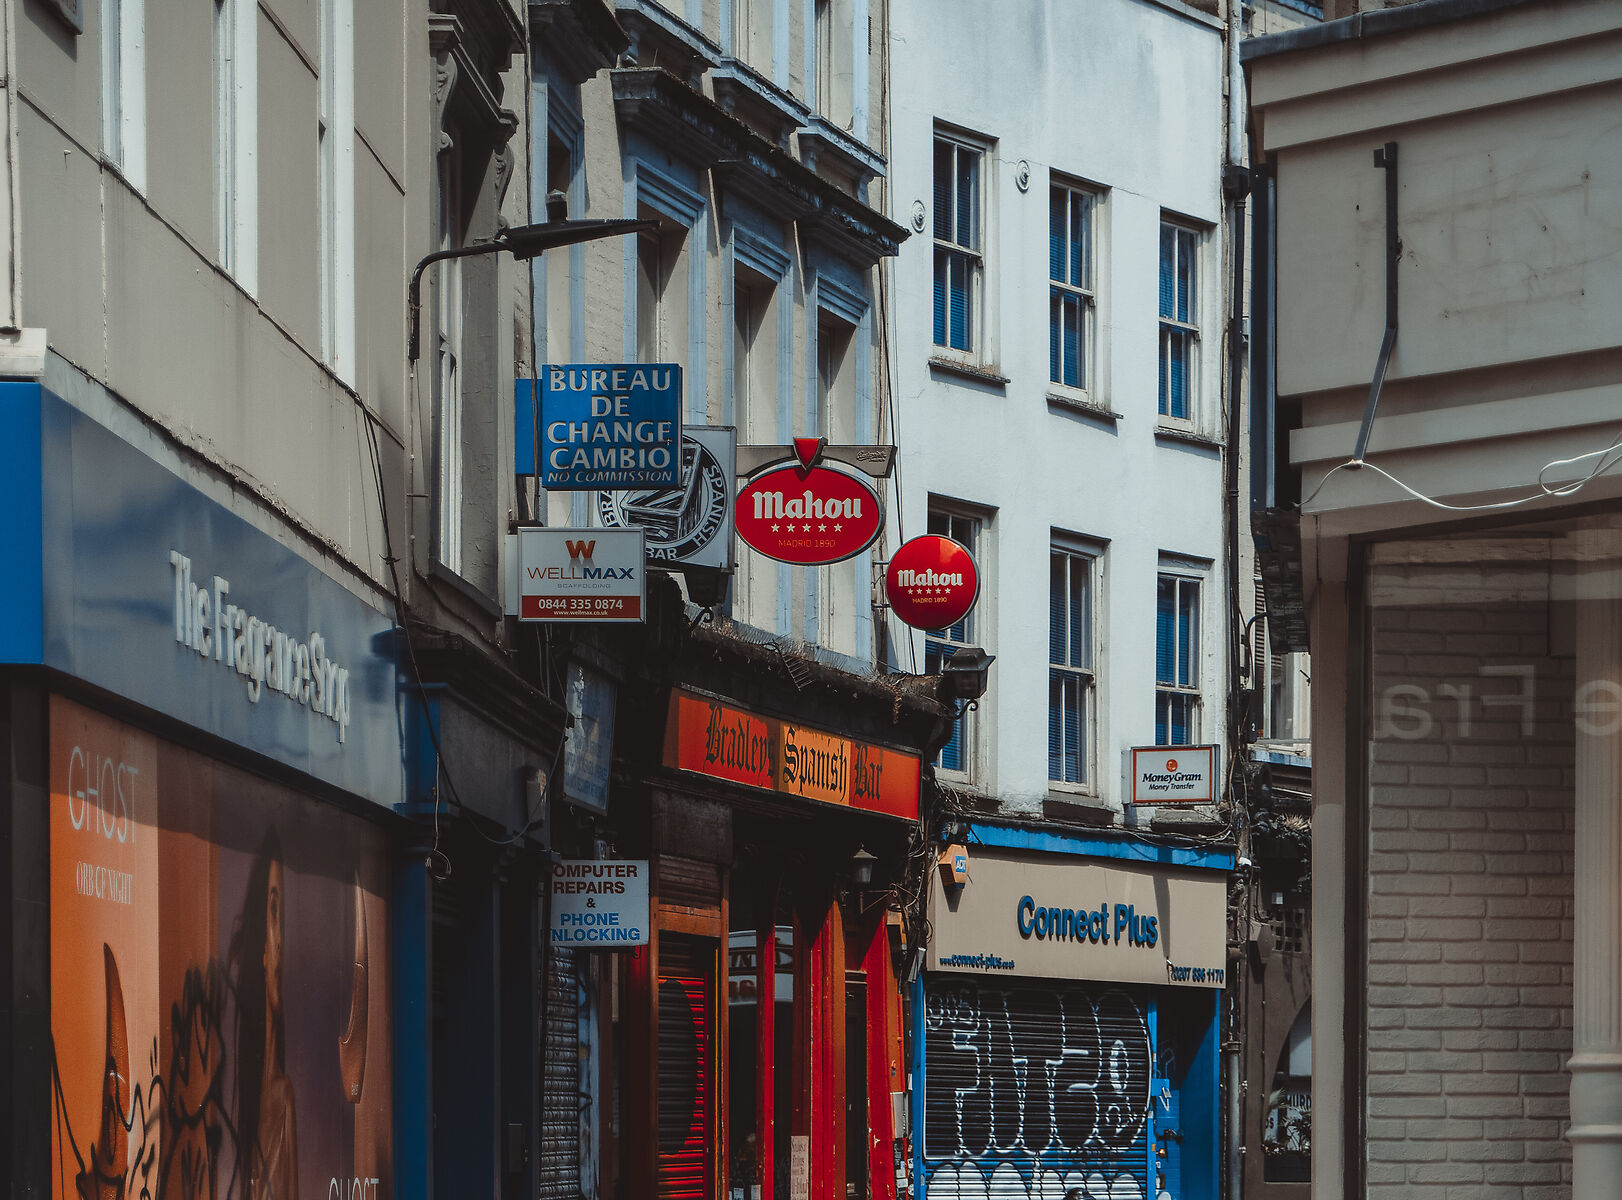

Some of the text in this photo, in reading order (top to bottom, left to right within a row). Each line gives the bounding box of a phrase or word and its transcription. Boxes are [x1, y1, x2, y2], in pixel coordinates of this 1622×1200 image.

[549, 369, 671, 392] BUREAU
[591, 395, 630, 417] DE
[547, 421, 672, 444] CHANGE
[549, 447, 671, 470] CAMBIO
[547, 470, 673, 483] NO COMMISSION
[693, 464, 725, 547] SPANISH
[752, 489, 863, 519] Mahou
[778, 539, 836, 548] MADRID 1890
[527, 567, 634, 580] WELLMAX
[897, 568, 963, 587] Mahou
[538, 599, 623, 610] 0844 335 0874
[170, 550, 350, 743] The Fragrance Shop
[783, 725, 848, 802] Spanish
[853, 743, 883, 803] Bar
[1142, 772, 1202, 784] MoneyGram
[1149, 782, 1194, 791] Money Transfer
[68, 745, 139, 845] GHOST
[552, 865, 638, 878] OMPUTER
[956, 859, 966, 870] ADT
[107, 869, 133, 904] NIGHT
[553, 881, 625, 894] REPAIRS
[586, 897, 596, 908] &
[560, 912, 619, 926] PHONE
[1017, 895, 1158, 948] Connect Plus
[551, 927, 640, 942] NLOCKING
